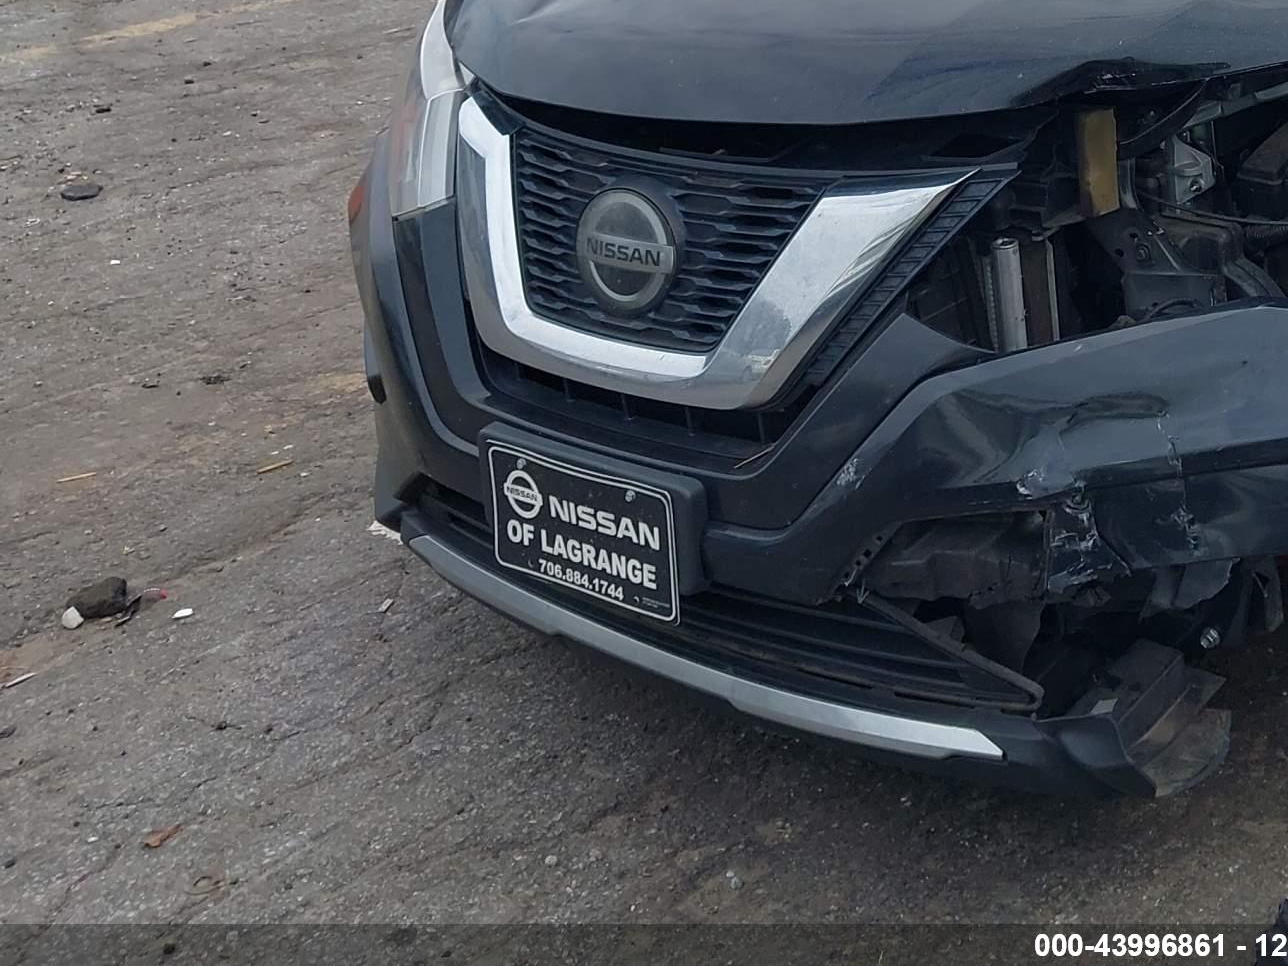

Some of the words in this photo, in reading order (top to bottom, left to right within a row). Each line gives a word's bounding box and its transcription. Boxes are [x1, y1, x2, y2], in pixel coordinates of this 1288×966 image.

[586, 237, 660, 267] NISSAN
[506, 485, 538, 503] NISSAN
[549, 494, 661, 551] NISSAN
[507, 519, 535, 547] OF
[541, 528, 658, 590] LAGRANGE
[538, 559, 625, 601] 706.884.1744
